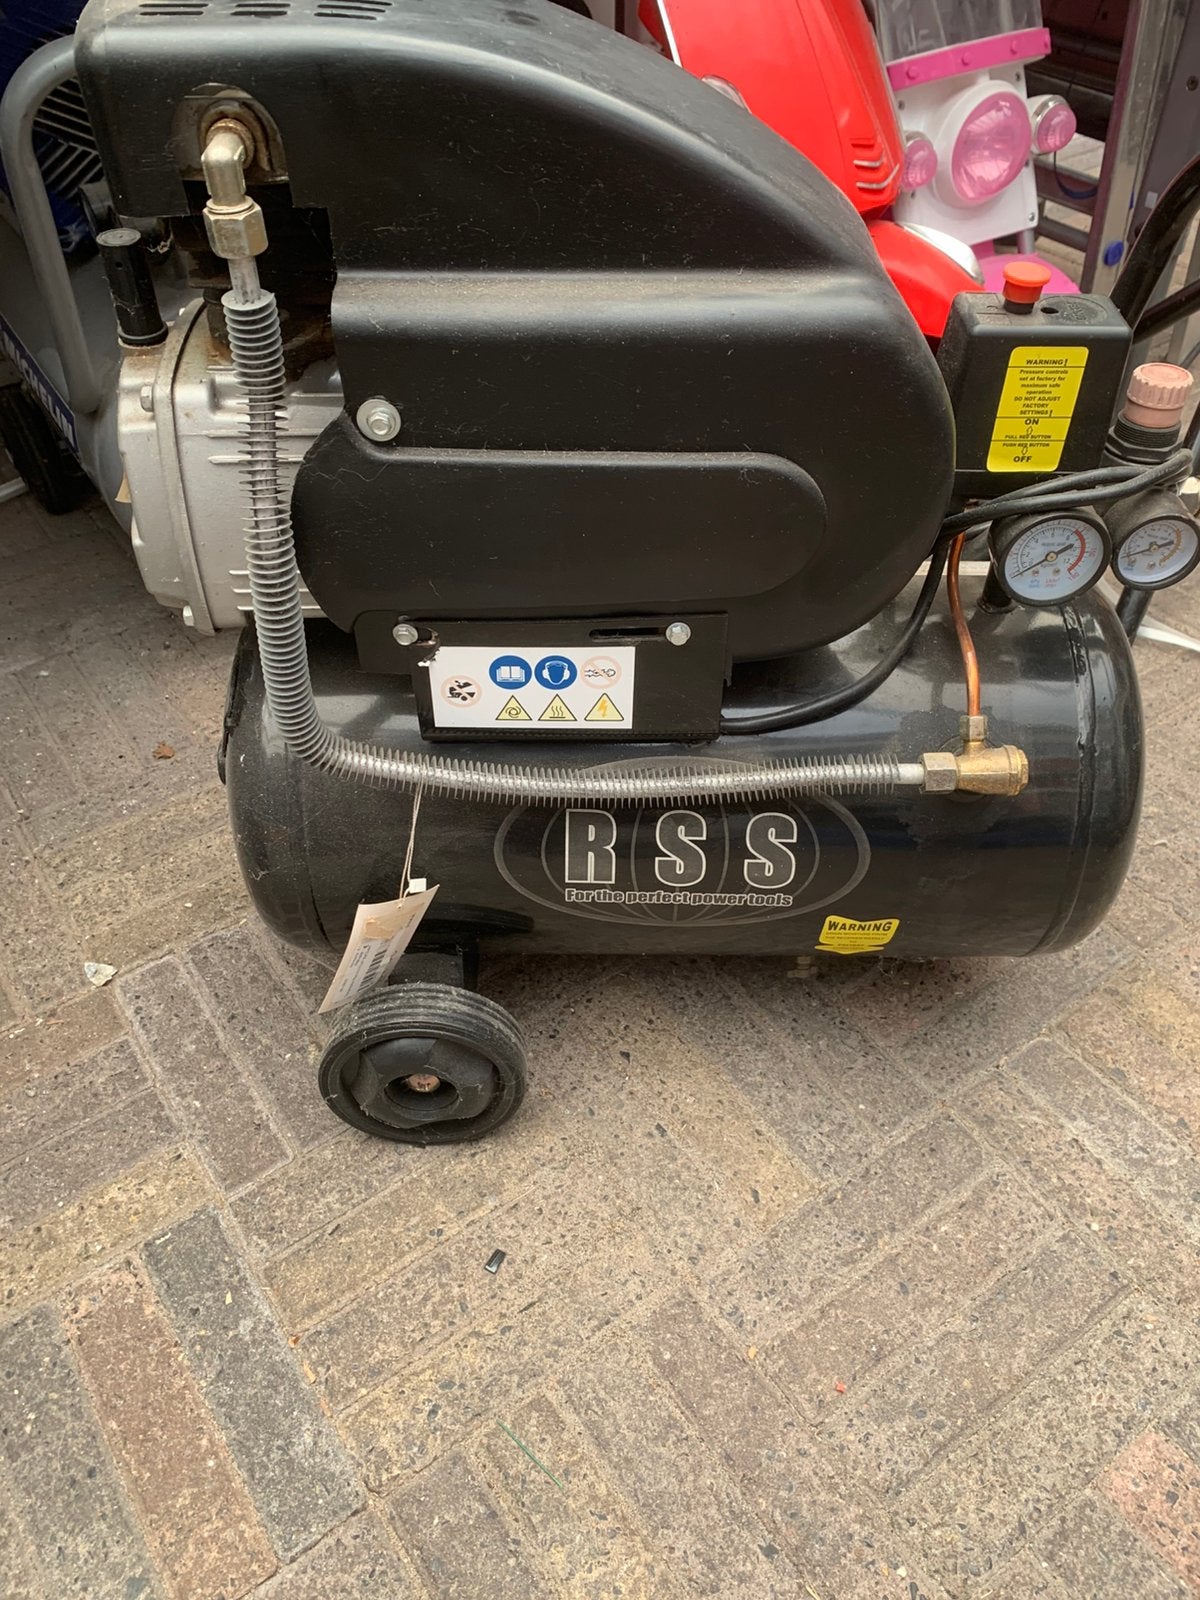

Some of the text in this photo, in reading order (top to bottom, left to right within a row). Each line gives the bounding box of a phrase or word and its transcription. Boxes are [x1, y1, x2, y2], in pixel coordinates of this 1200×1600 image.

[565, 888, 793, 907] For the perfect power tools
[827, 920, 893, 932] WARNING
